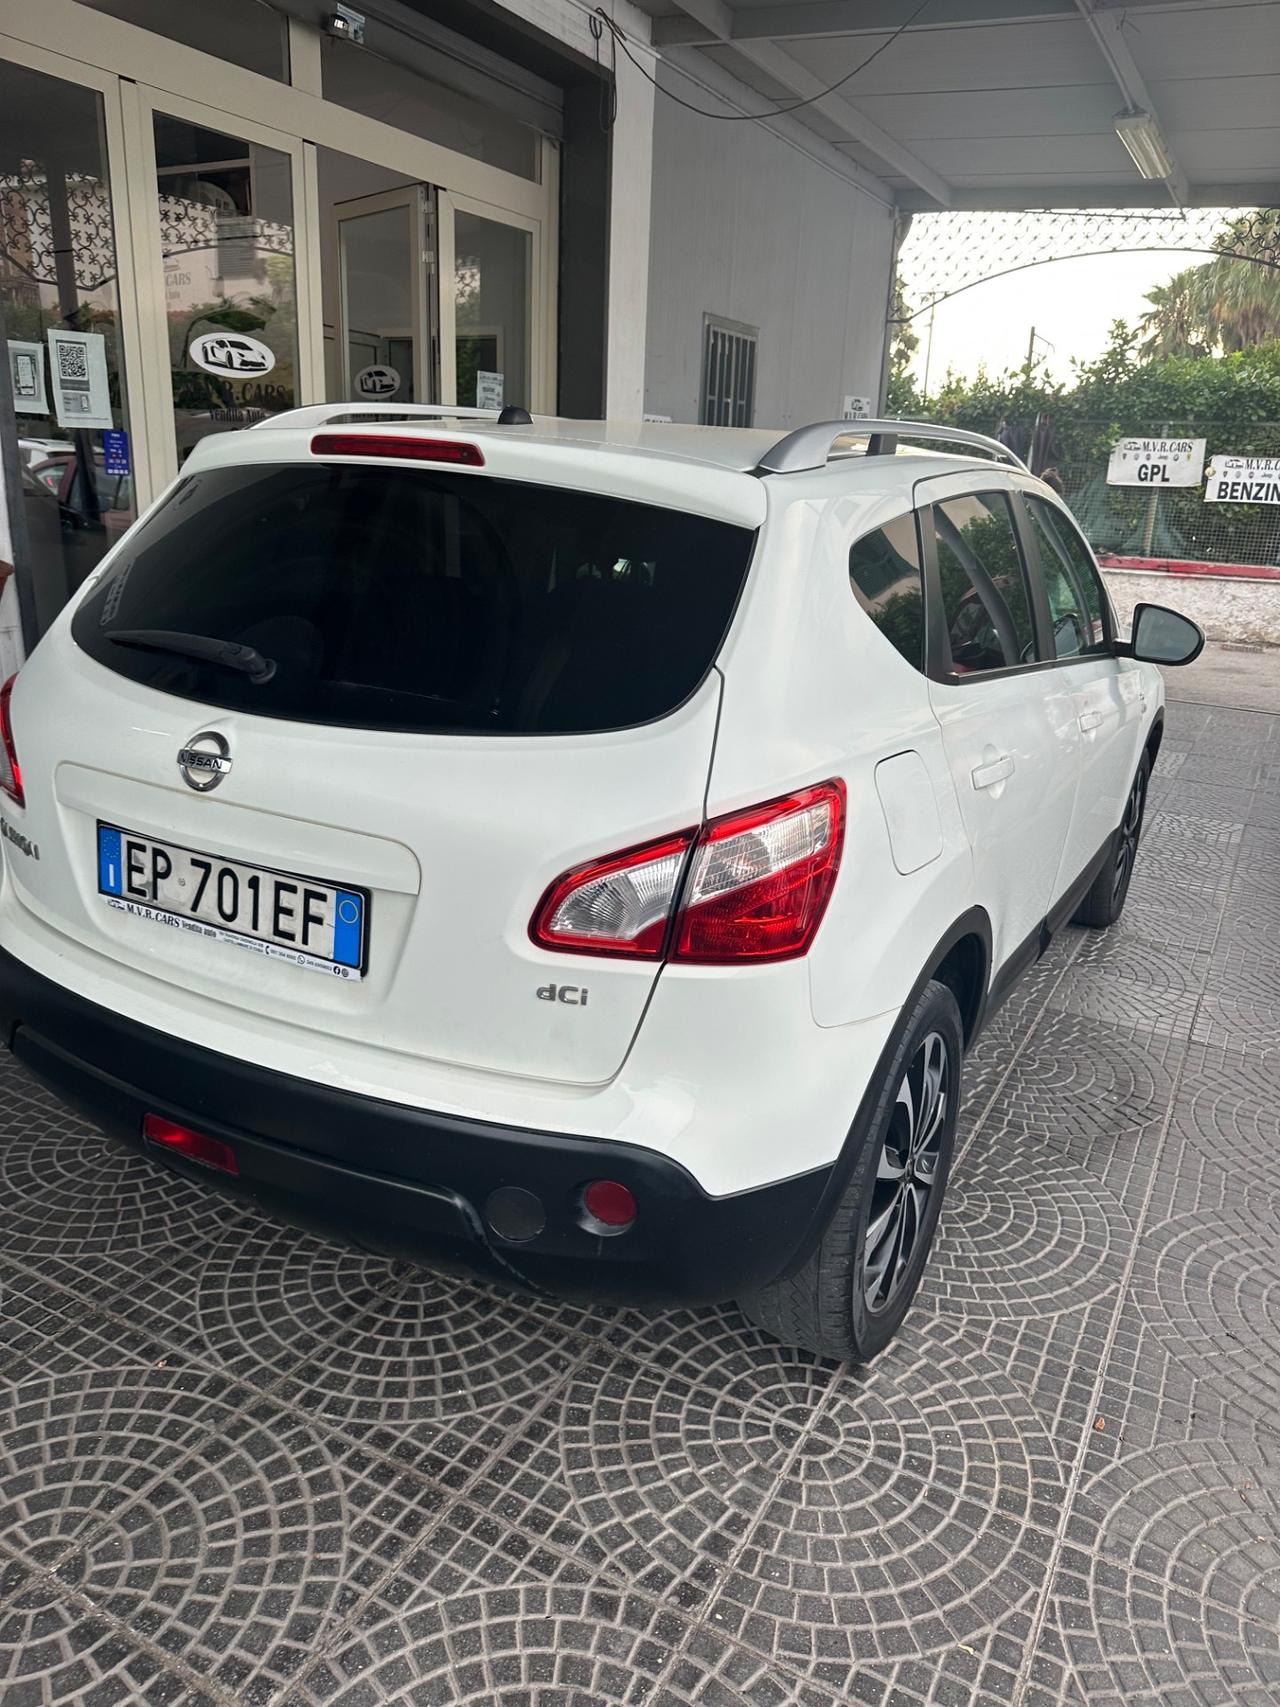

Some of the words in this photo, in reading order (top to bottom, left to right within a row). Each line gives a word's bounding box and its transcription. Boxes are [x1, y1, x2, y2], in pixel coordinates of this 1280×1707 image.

[1138, 464, 1170, 482] GPL
[1217, 481, 1280, 502] BENZIN
[181, 751, 223, 770] NISSAN
[126, 840, 172, 901] EP
[190, 857, 328, 946] 701EF
[536, 983, 589, 1006] dCi
